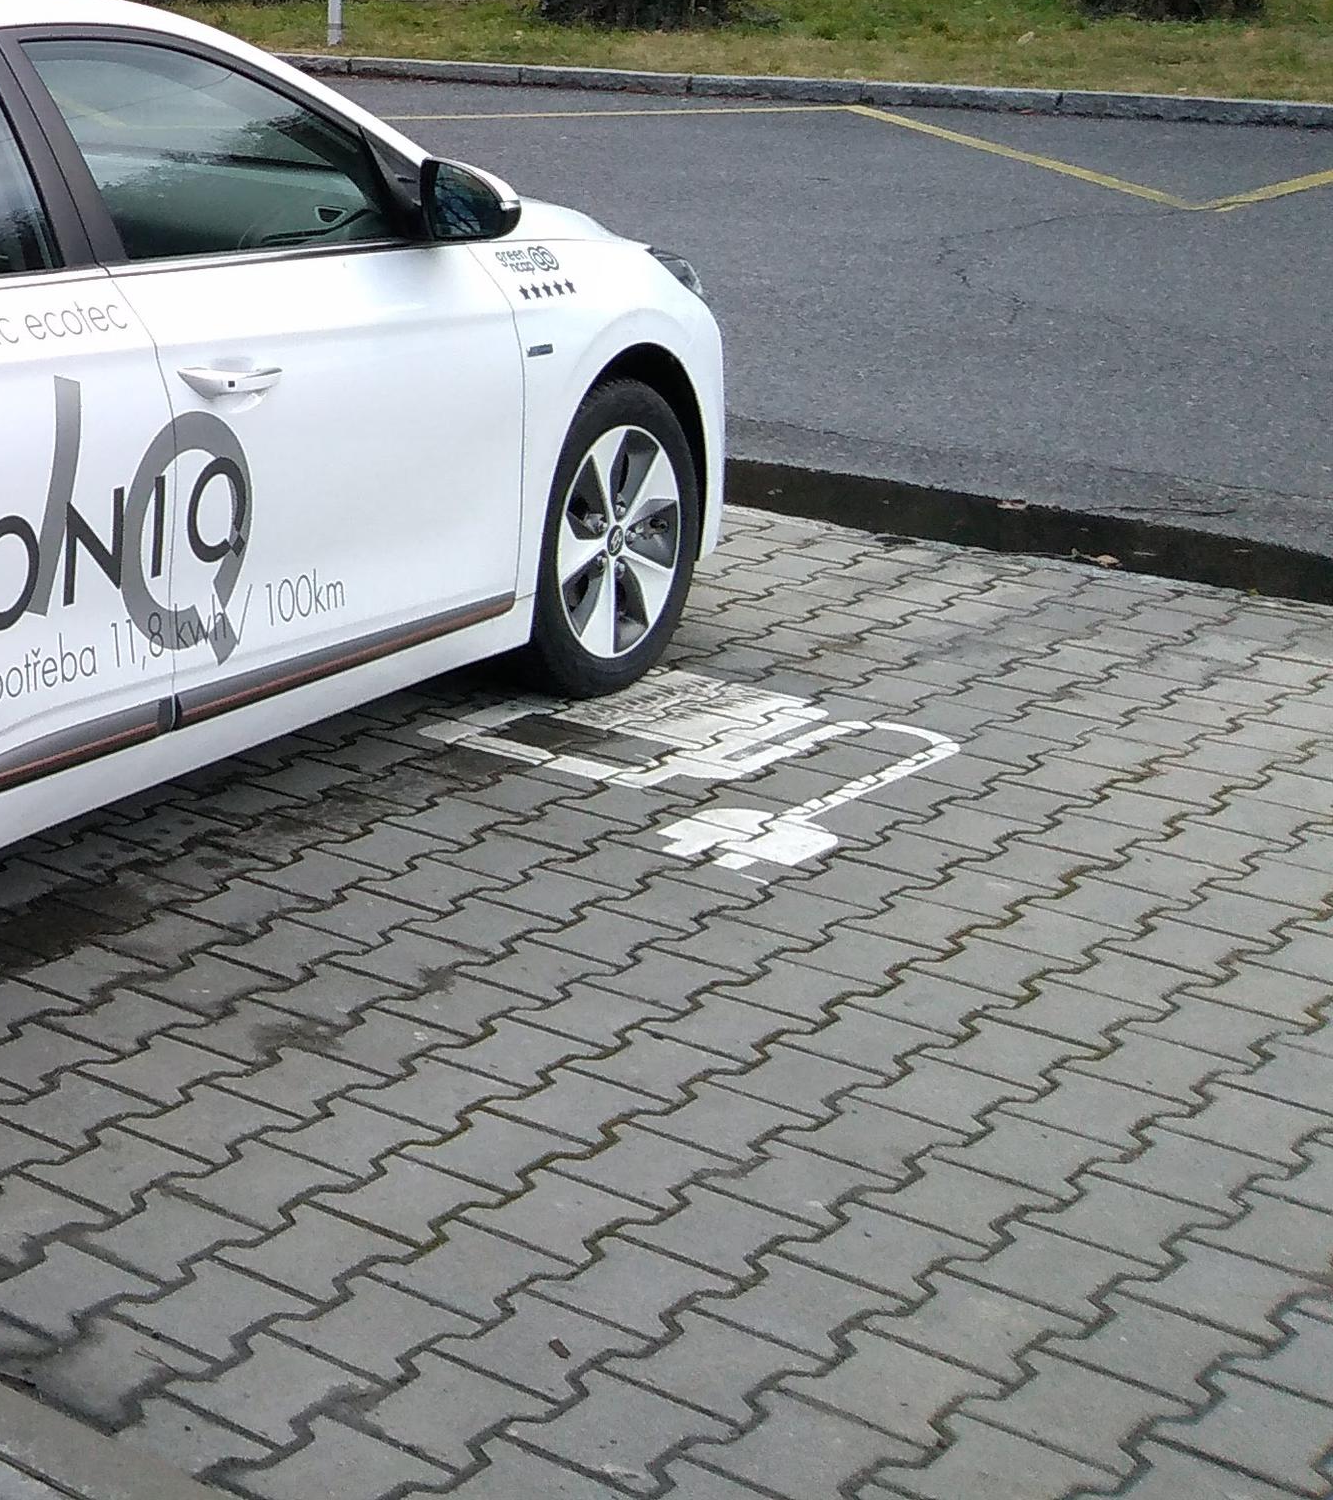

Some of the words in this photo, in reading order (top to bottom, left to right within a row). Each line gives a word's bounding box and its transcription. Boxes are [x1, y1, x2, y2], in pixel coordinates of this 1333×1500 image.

[494, 249, 528, 268] green
[24, 300, 128, 341] ecotec
[110, 610, 166, 670] 11,8
[174, 593, 228, 651] kwh
[265, 568, 346, 626] 100km
